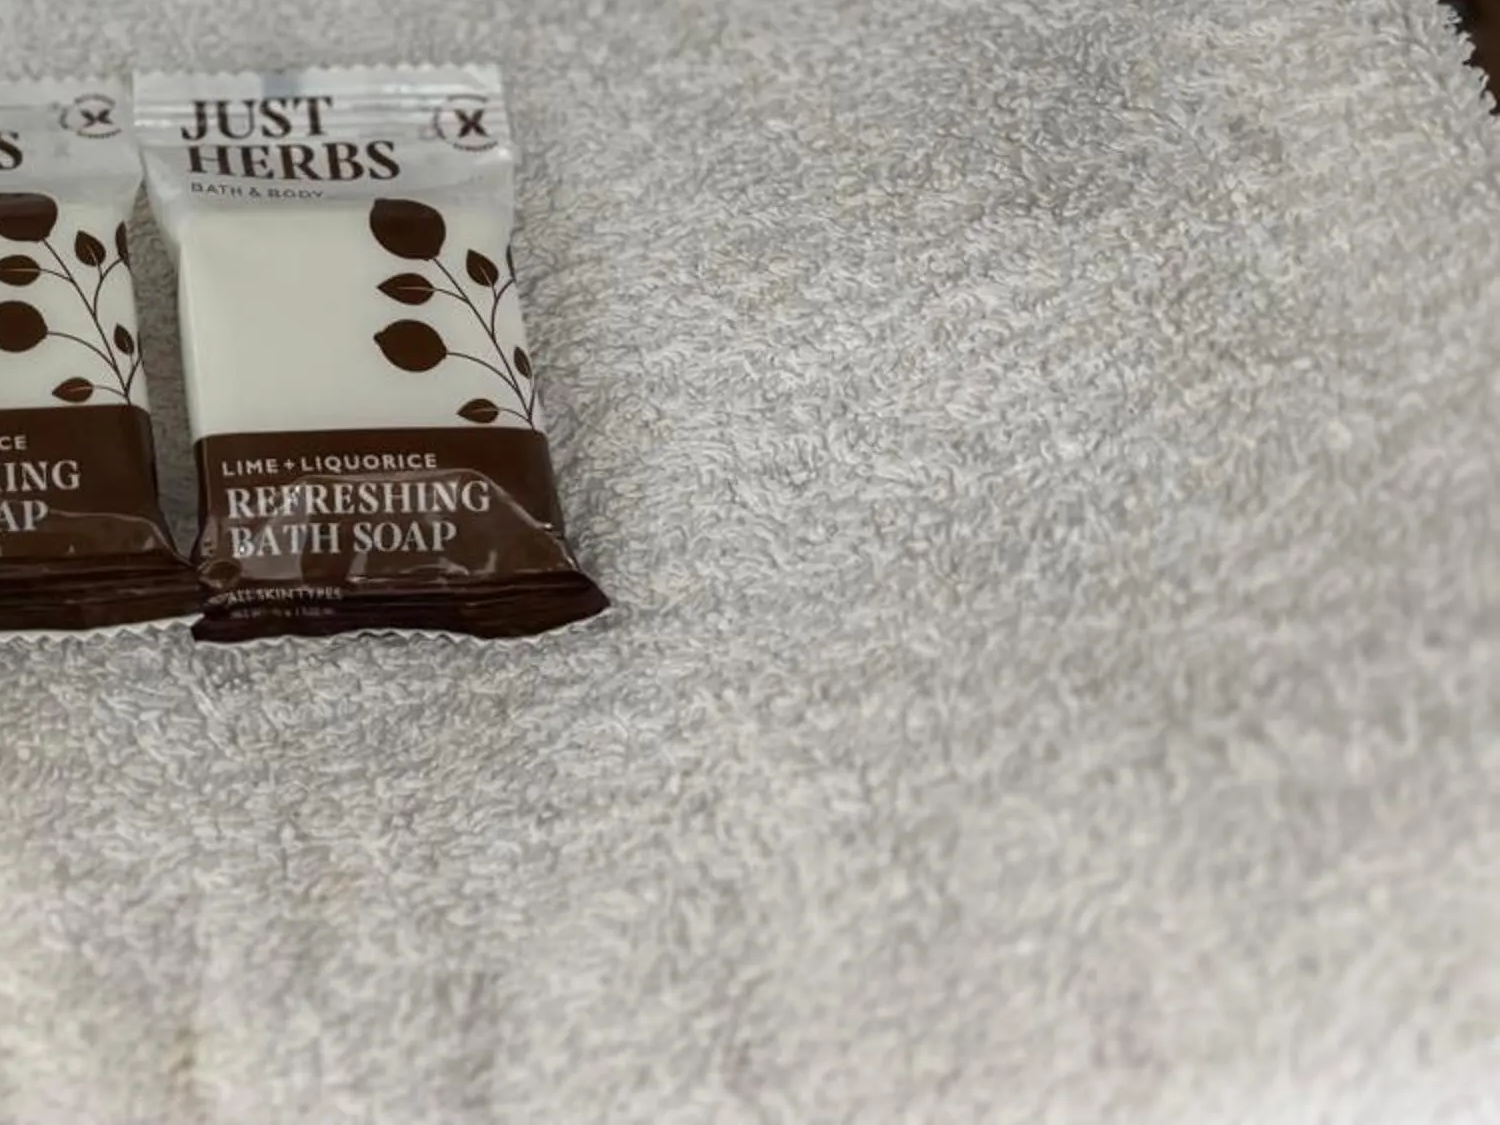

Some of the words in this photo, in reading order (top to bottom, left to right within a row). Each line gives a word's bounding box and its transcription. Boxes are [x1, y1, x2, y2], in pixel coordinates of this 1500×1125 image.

[181, 95, 333, 141] JUST
[187, 140, 401, 181] HERBS
[191, 182, 244, 198] BATH
[248, 188, 262, 198] &
[267, 189, 324, 199] BODY
[226, 480, 490, 520] REFRESHING
[230, 522, 342, 558] BATH
[353, 519, 457, 553] SOAP
[256, 587, 293, 600] SKIN
